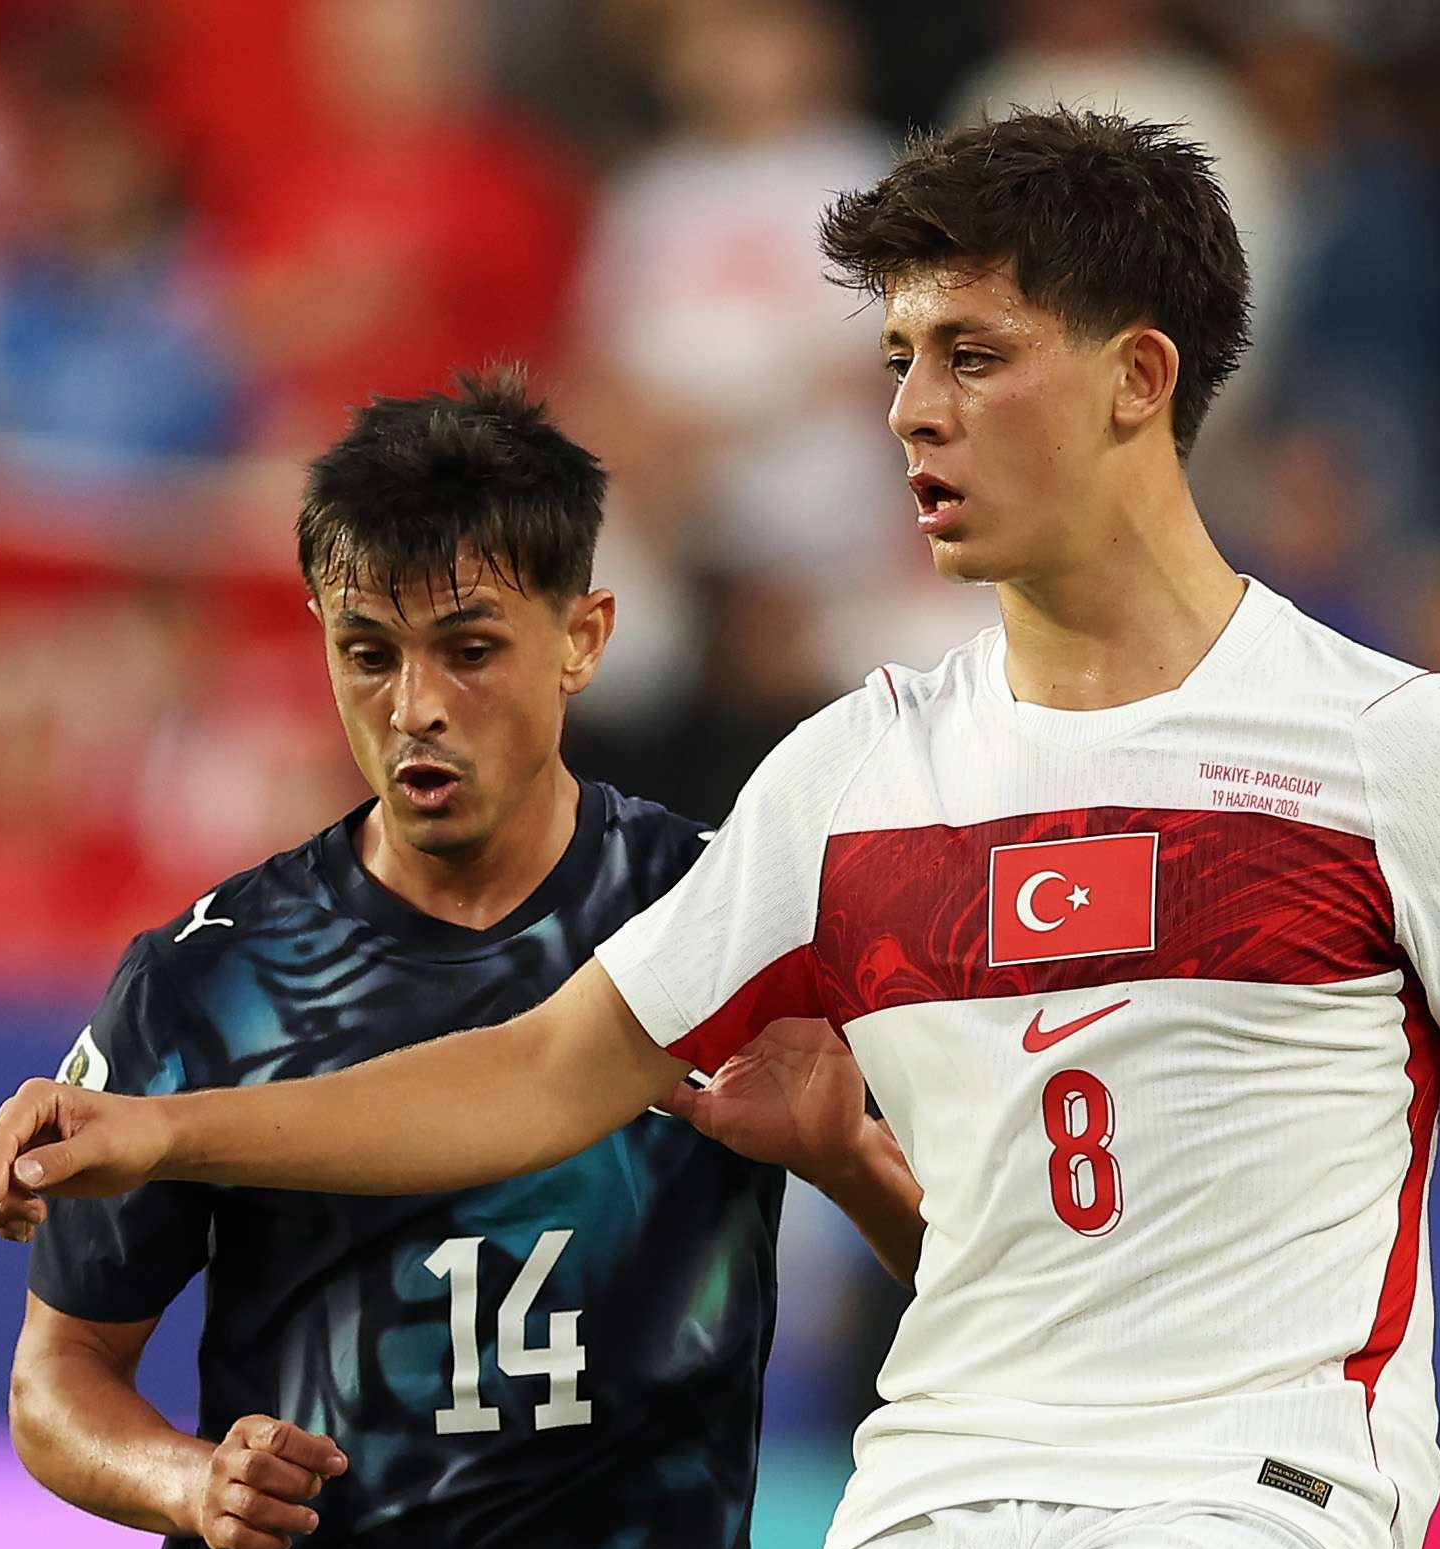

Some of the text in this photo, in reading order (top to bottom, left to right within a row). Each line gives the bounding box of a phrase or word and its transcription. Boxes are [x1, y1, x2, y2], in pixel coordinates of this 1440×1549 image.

[1199, 761, 1322, 797] TÜRKİYE-PARAGUAY
[1212, 789, 1300, 818] 19 HAZİRAN 2026
[1042, 1069, 1124, 1237] 8
[423, 1229, 592, 1435] 14
